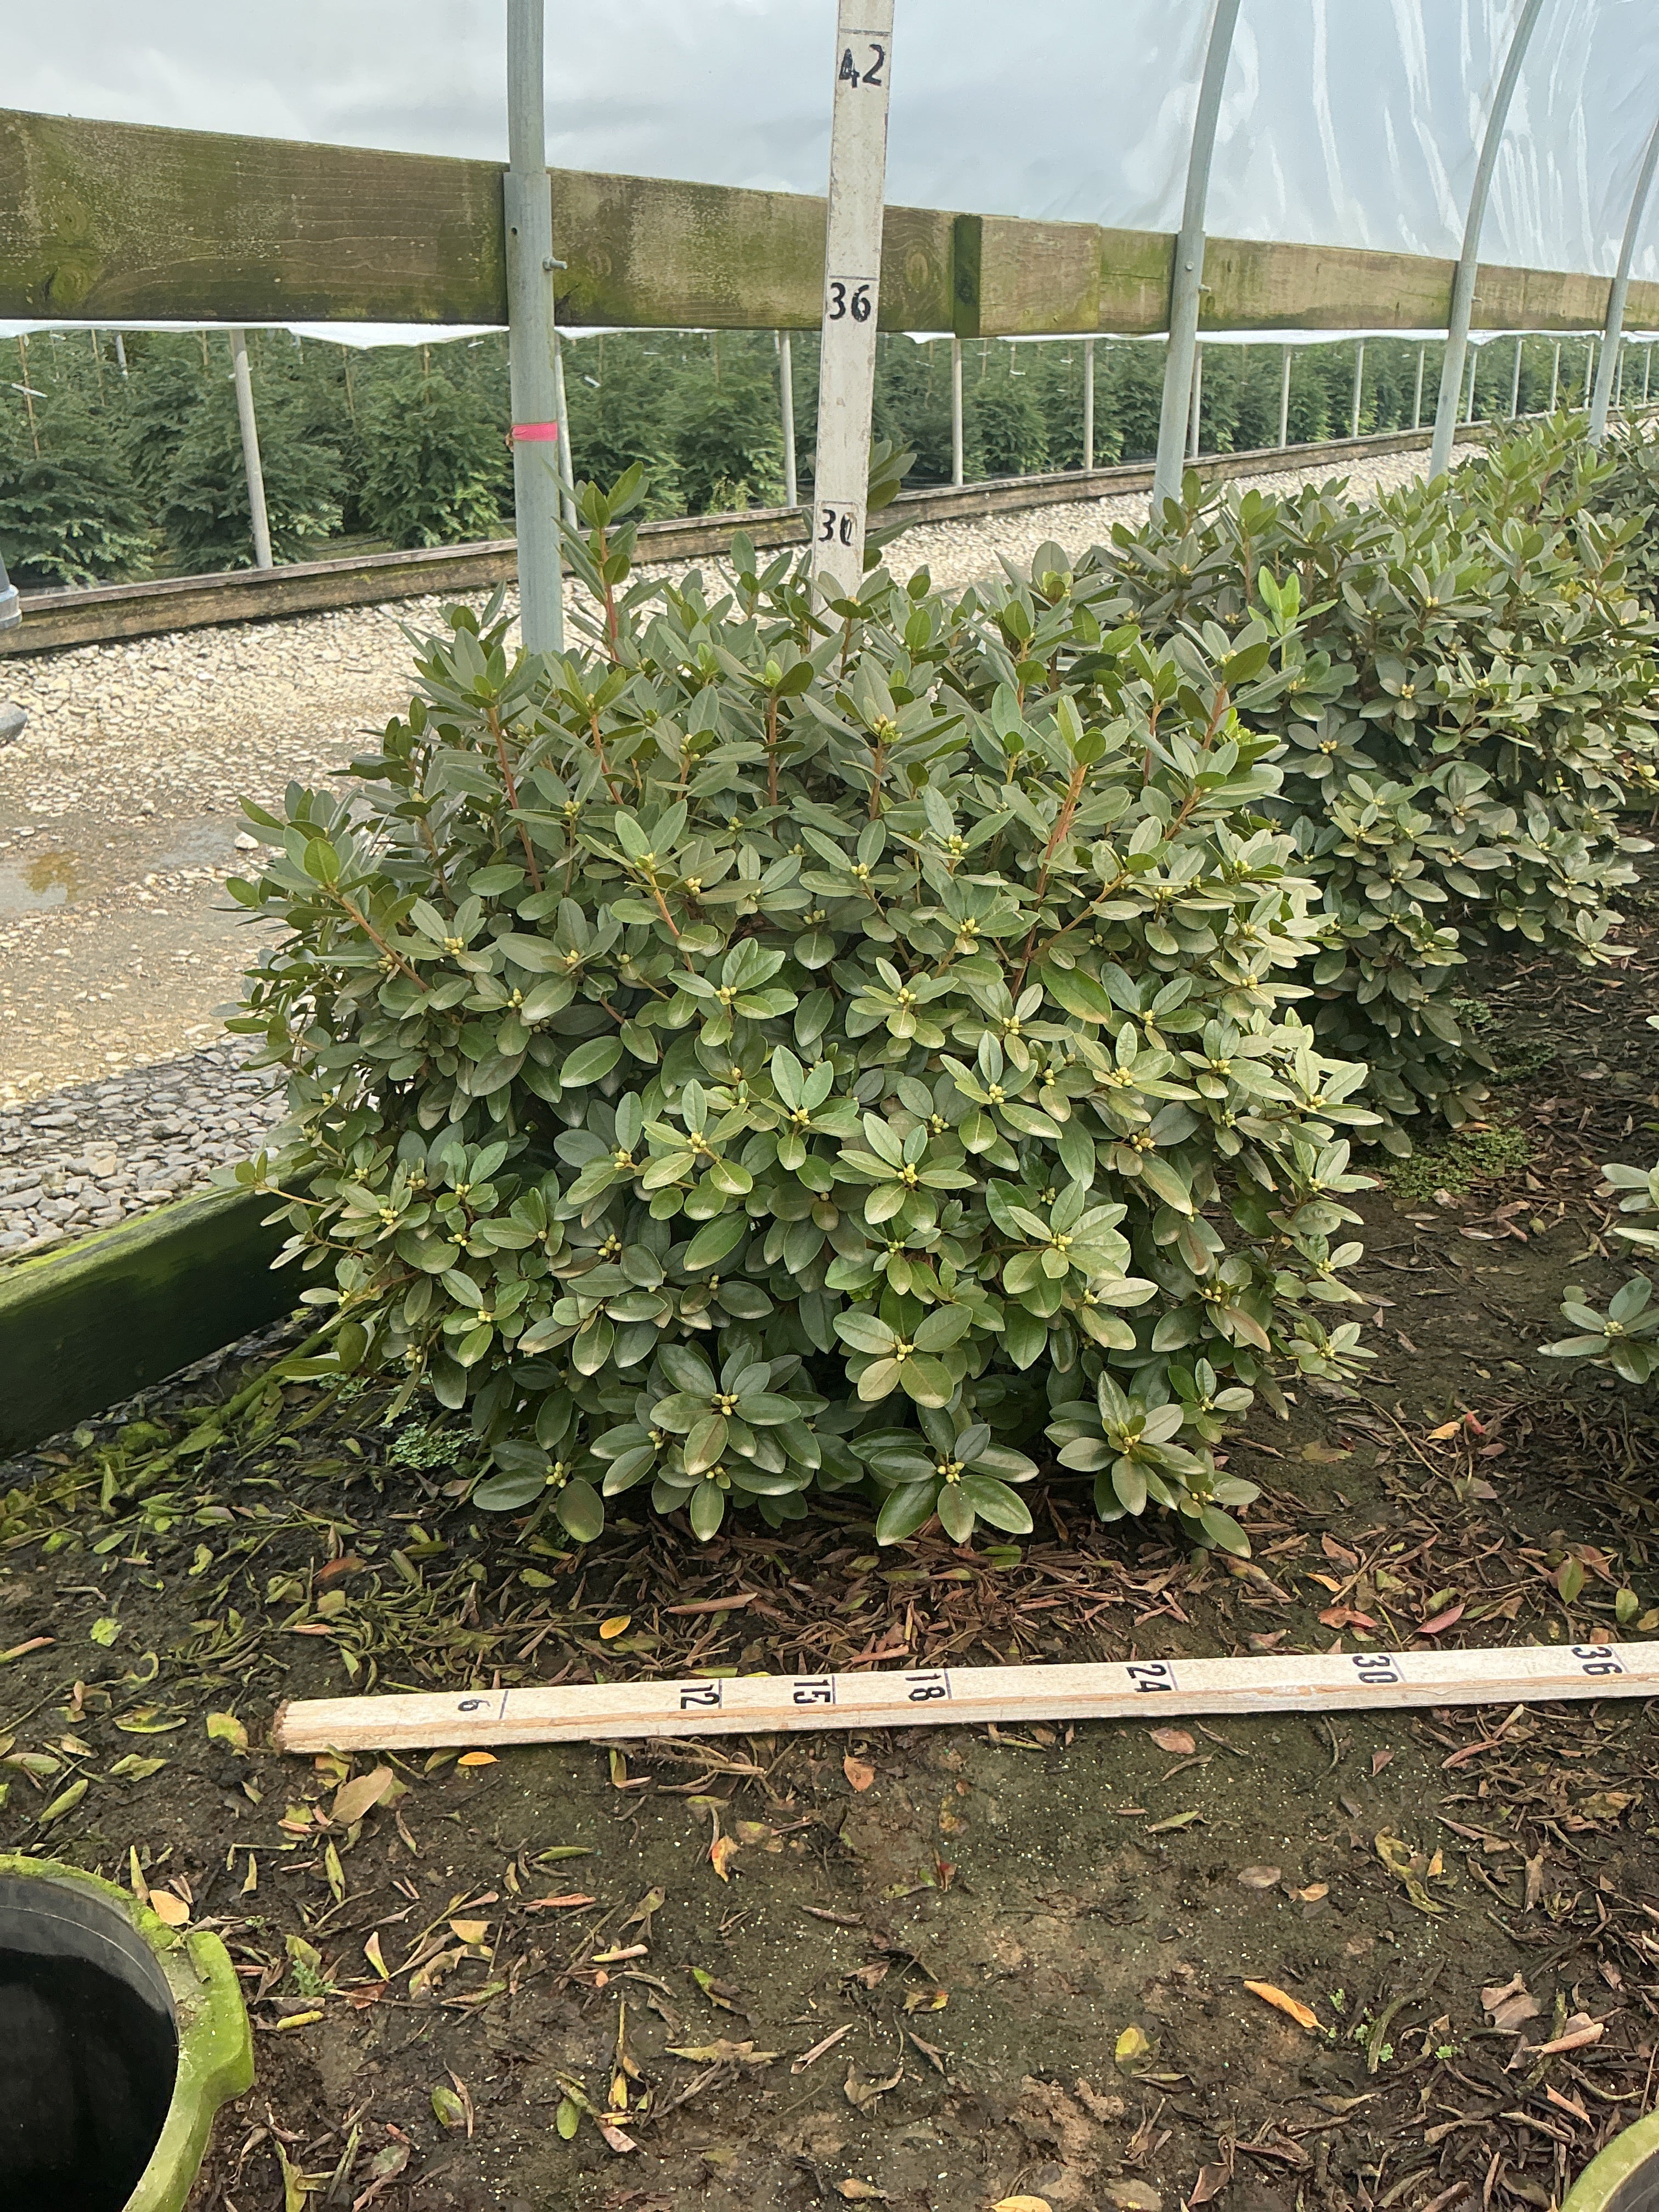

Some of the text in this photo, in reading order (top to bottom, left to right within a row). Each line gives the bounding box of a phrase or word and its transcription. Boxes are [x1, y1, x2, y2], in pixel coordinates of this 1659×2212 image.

[839, 44, 885, 88] 42
[829, 283, 871, 323] 36
[818, 509, 856, 547] 30
[1352, 1655, 1398, 1684] 30
[1572, 1646, 1623, 1675] 36
[793, 1679, 831, 1703] 15
[905, 1673, 946, 1701] 18
[1125, 1663, 1172, 1692] 24
[458, 1699, 490, 1711] 6
[680, 1684, 719, 1709] 12
